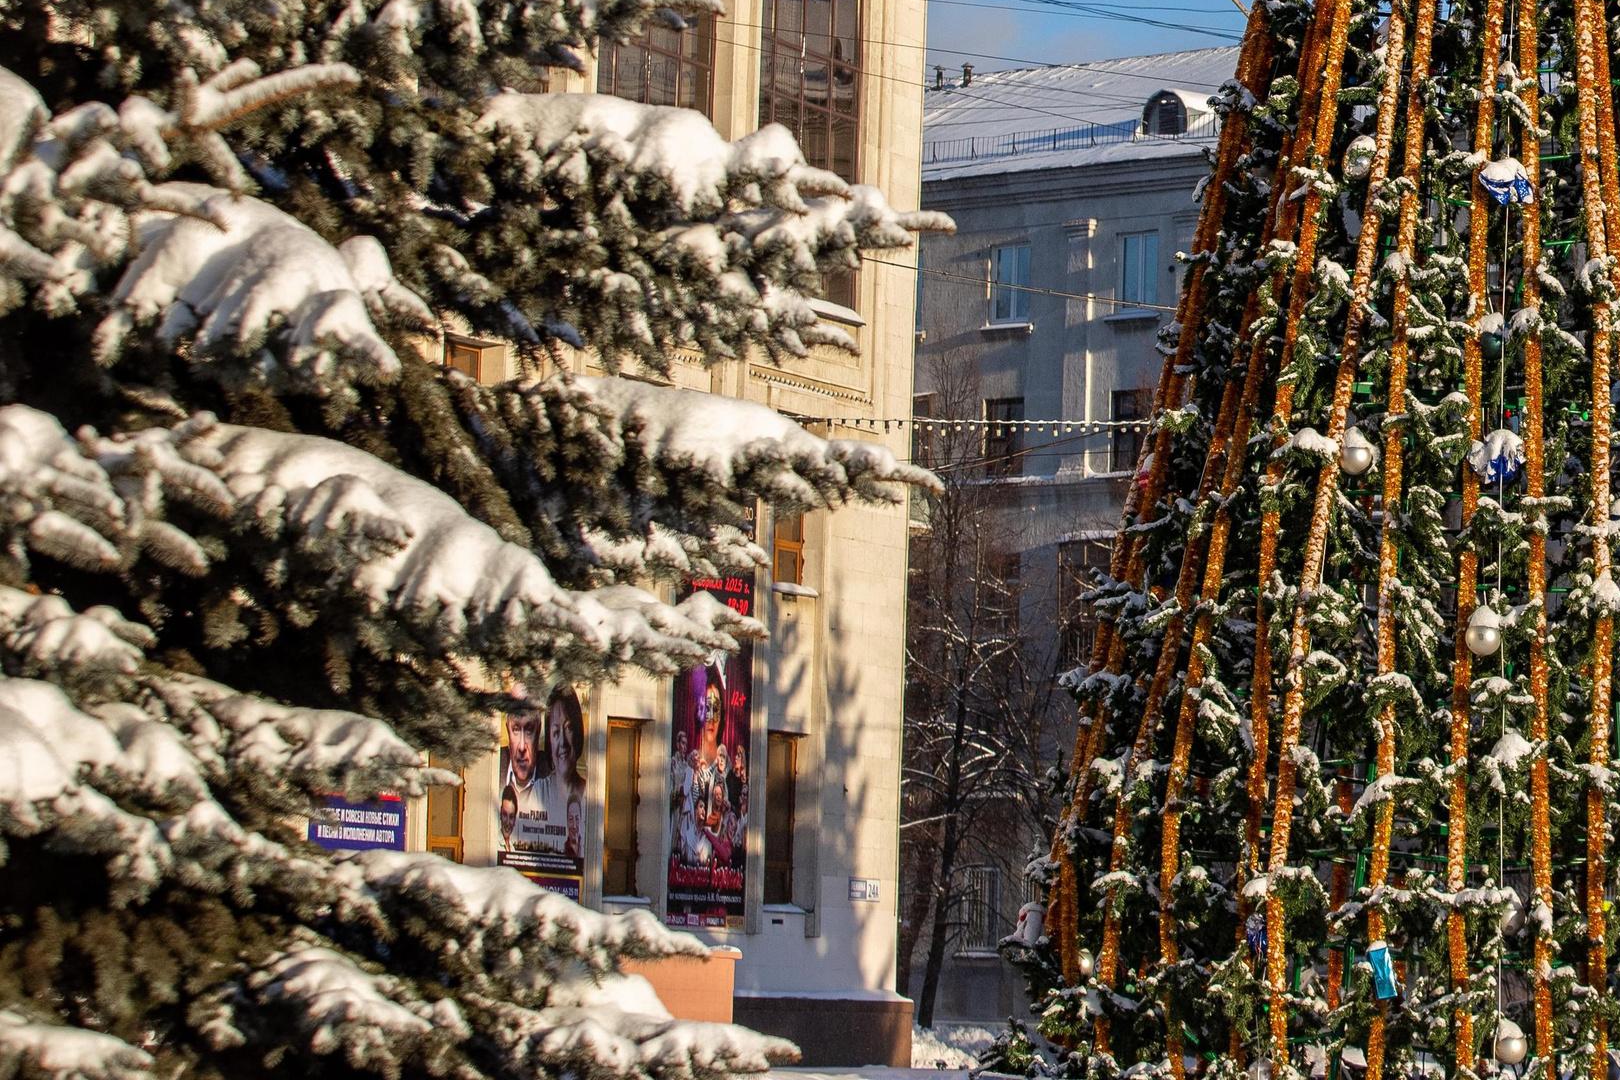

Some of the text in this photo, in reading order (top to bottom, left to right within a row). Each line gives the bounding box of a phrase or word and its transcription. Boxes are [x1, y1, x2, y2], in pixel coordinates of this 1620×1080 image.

[725, 577, 743, 593] 2025
[346, 809, 364, 824] СОВСЕМ
[366, 812, 382, 825] НОВЫЕ
[383, 813, 400, 826] СТИХИ
[343, 827, 375, 842] ИСПОЛНЕНИИ
[376, 830, 395, 843] АВТОРА
